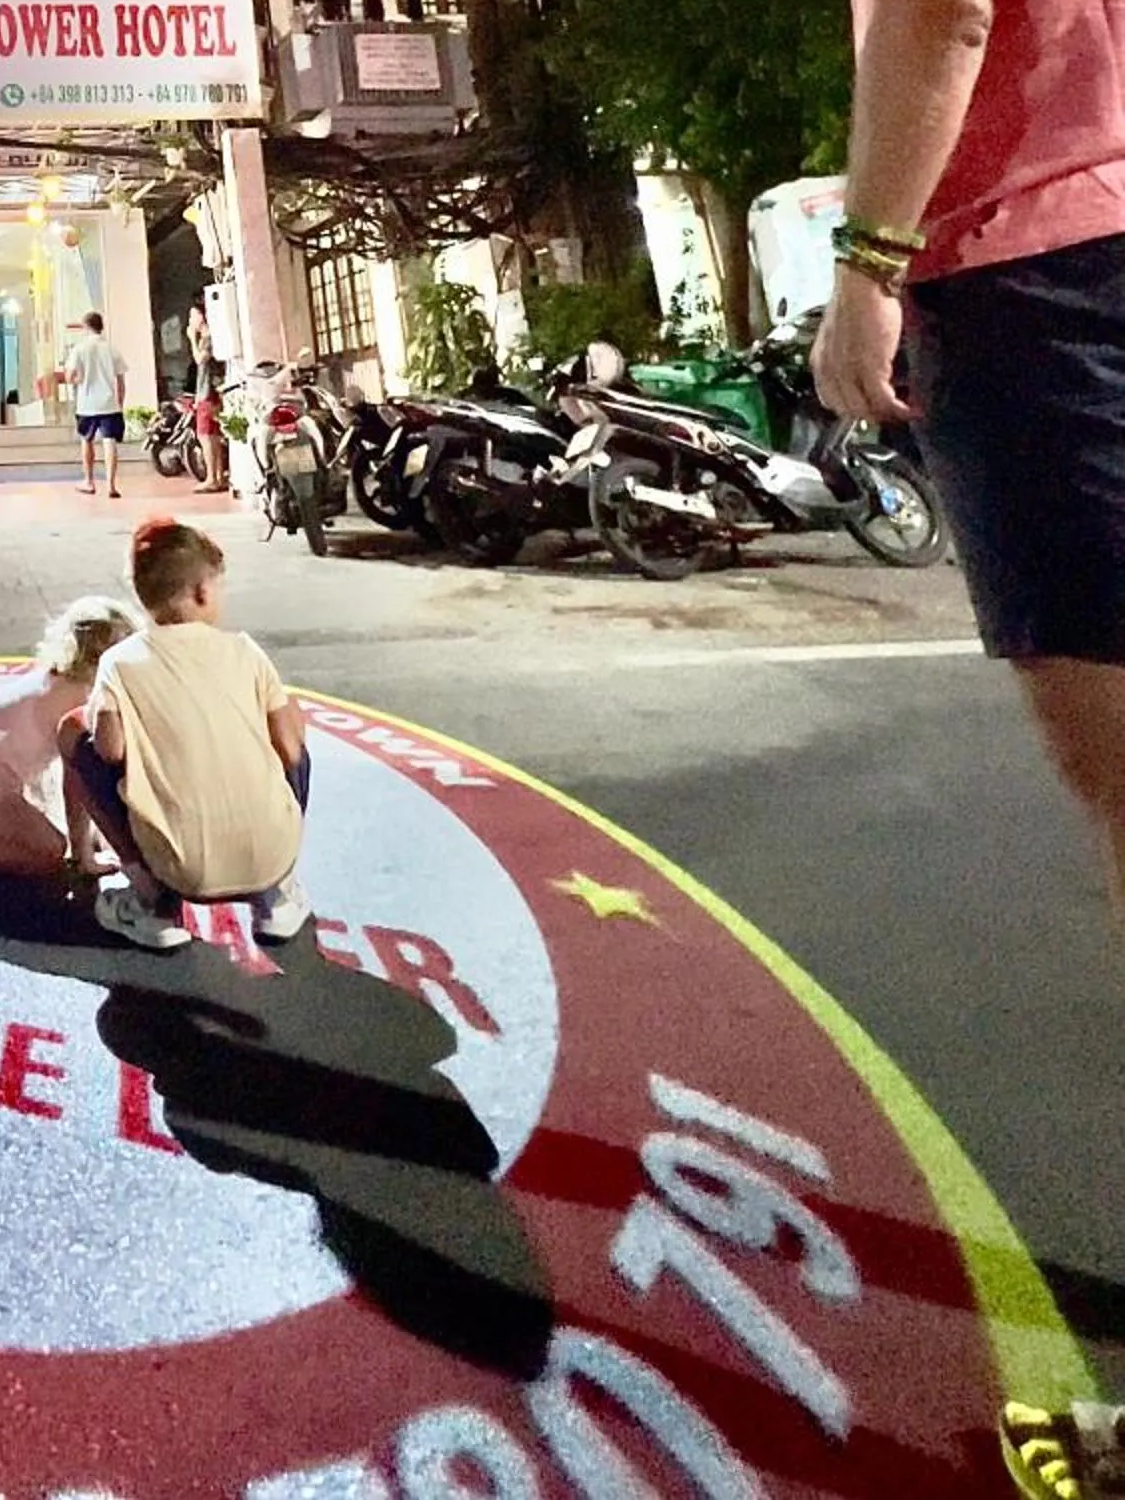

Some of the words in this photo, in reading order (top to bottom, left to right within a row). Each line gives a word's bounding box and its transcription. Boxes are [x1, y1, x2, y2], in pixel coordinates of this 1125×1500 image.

[114, 3, 236, 58] HOTEL
[58, 83, 81, 104] 398
[84, 83, 108, 104] 813
[111, 83, 135, 104] 313
